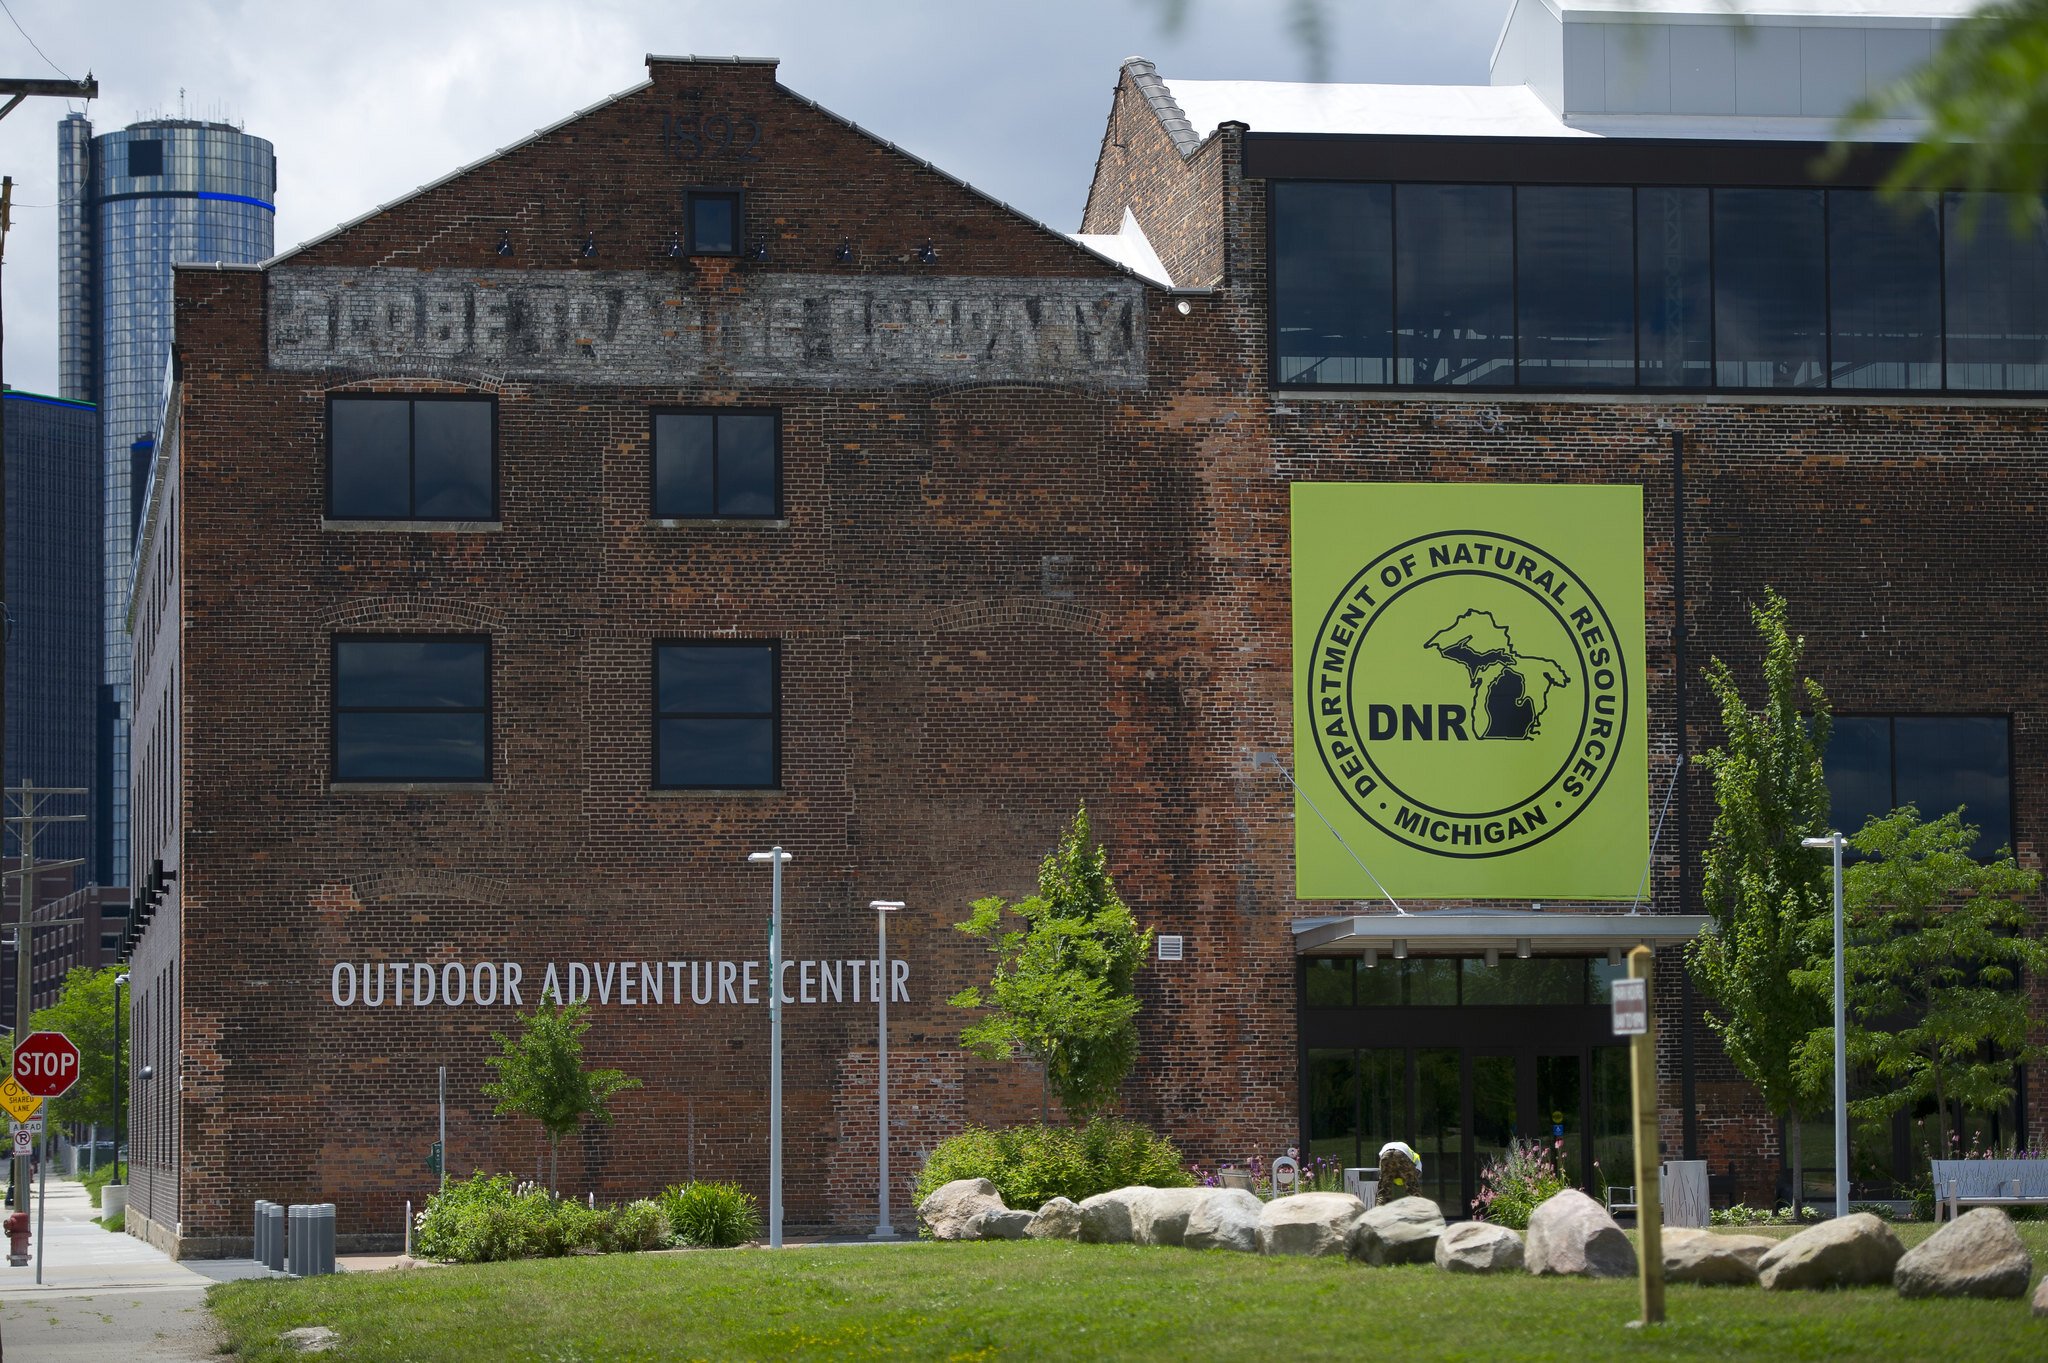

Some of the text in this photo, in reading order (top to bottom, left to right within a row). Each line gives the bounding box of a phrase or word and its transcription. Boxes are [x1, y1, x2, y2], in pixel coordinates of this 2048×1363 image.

[661, 109, 762, 162] 1892
[1320, 542, 1616, 799] DEPARTMENT OF NATURAL RESOURCES
[1368, 703, 1469, 741] DNR
[1393, 804, 1549, 846] MICHIGAN
[331, 962, 524, 1007] OUTDOOR
[541, 961, 760, 1005] ADVENTURE
[780, 959, 911, 1004] CENTER
[17, 1052, 75, 1077] STOP
[9, 1096, 34, 1104] SHARED
